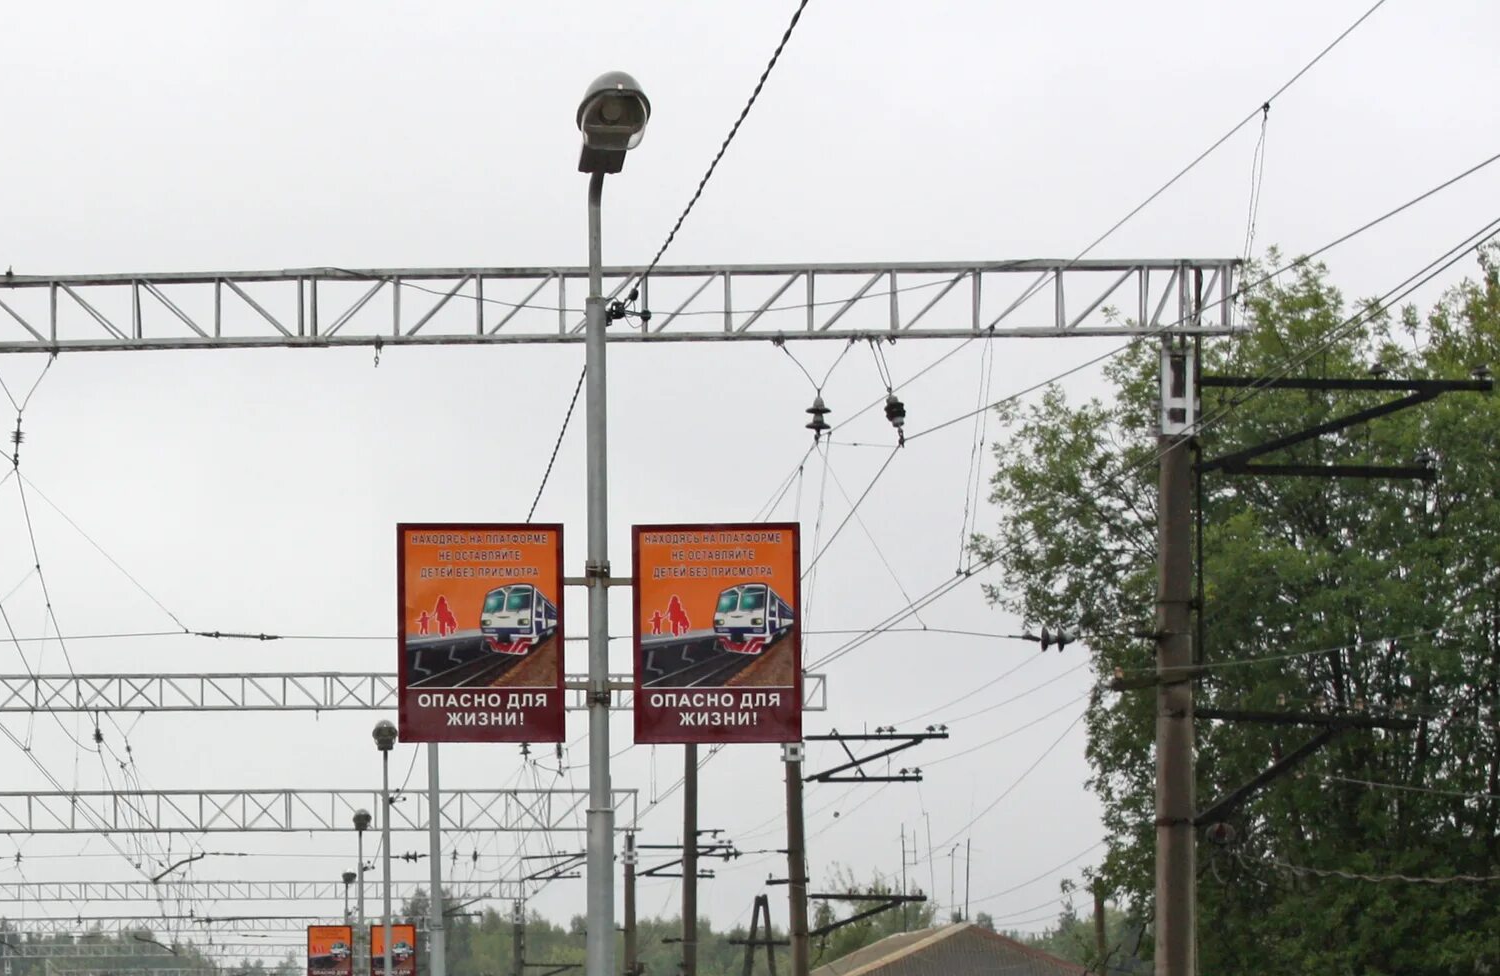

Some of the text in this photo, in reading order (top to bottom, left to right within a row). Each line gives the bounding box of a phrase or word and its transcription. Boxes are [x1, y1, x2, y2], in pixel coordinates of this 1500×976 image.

[411, 534, 547, 544] НАХОДЯСЬ НА ПЛАТФОРМЕ
[644, 533, 781, 544] НАХОДЯСЬ НА ПЛАТФОРМЕ
[438, 549, 521, 561] НЕ ОСТАВЛЯЙТЕ
[671, 549, 755, 561] НЕ ОСТАВЛЯЙТЕ
[420, 566, 539, 578] ДЕТЕЙ БЕЗ ПРИСМОТРА
[653, 565, 773, 578] ДЕТЕЙ БЕЗ ПРИСМОТРА
[417, 693, 547, 710] ОПАСНО ДЛЯ
[650, 693, 781, 709] ОПАСНО ДЛЯ
[446, 712, 525, 726] ЖИЗНИ!
[679, 711, 758, 726] ЖИЗНИ!
